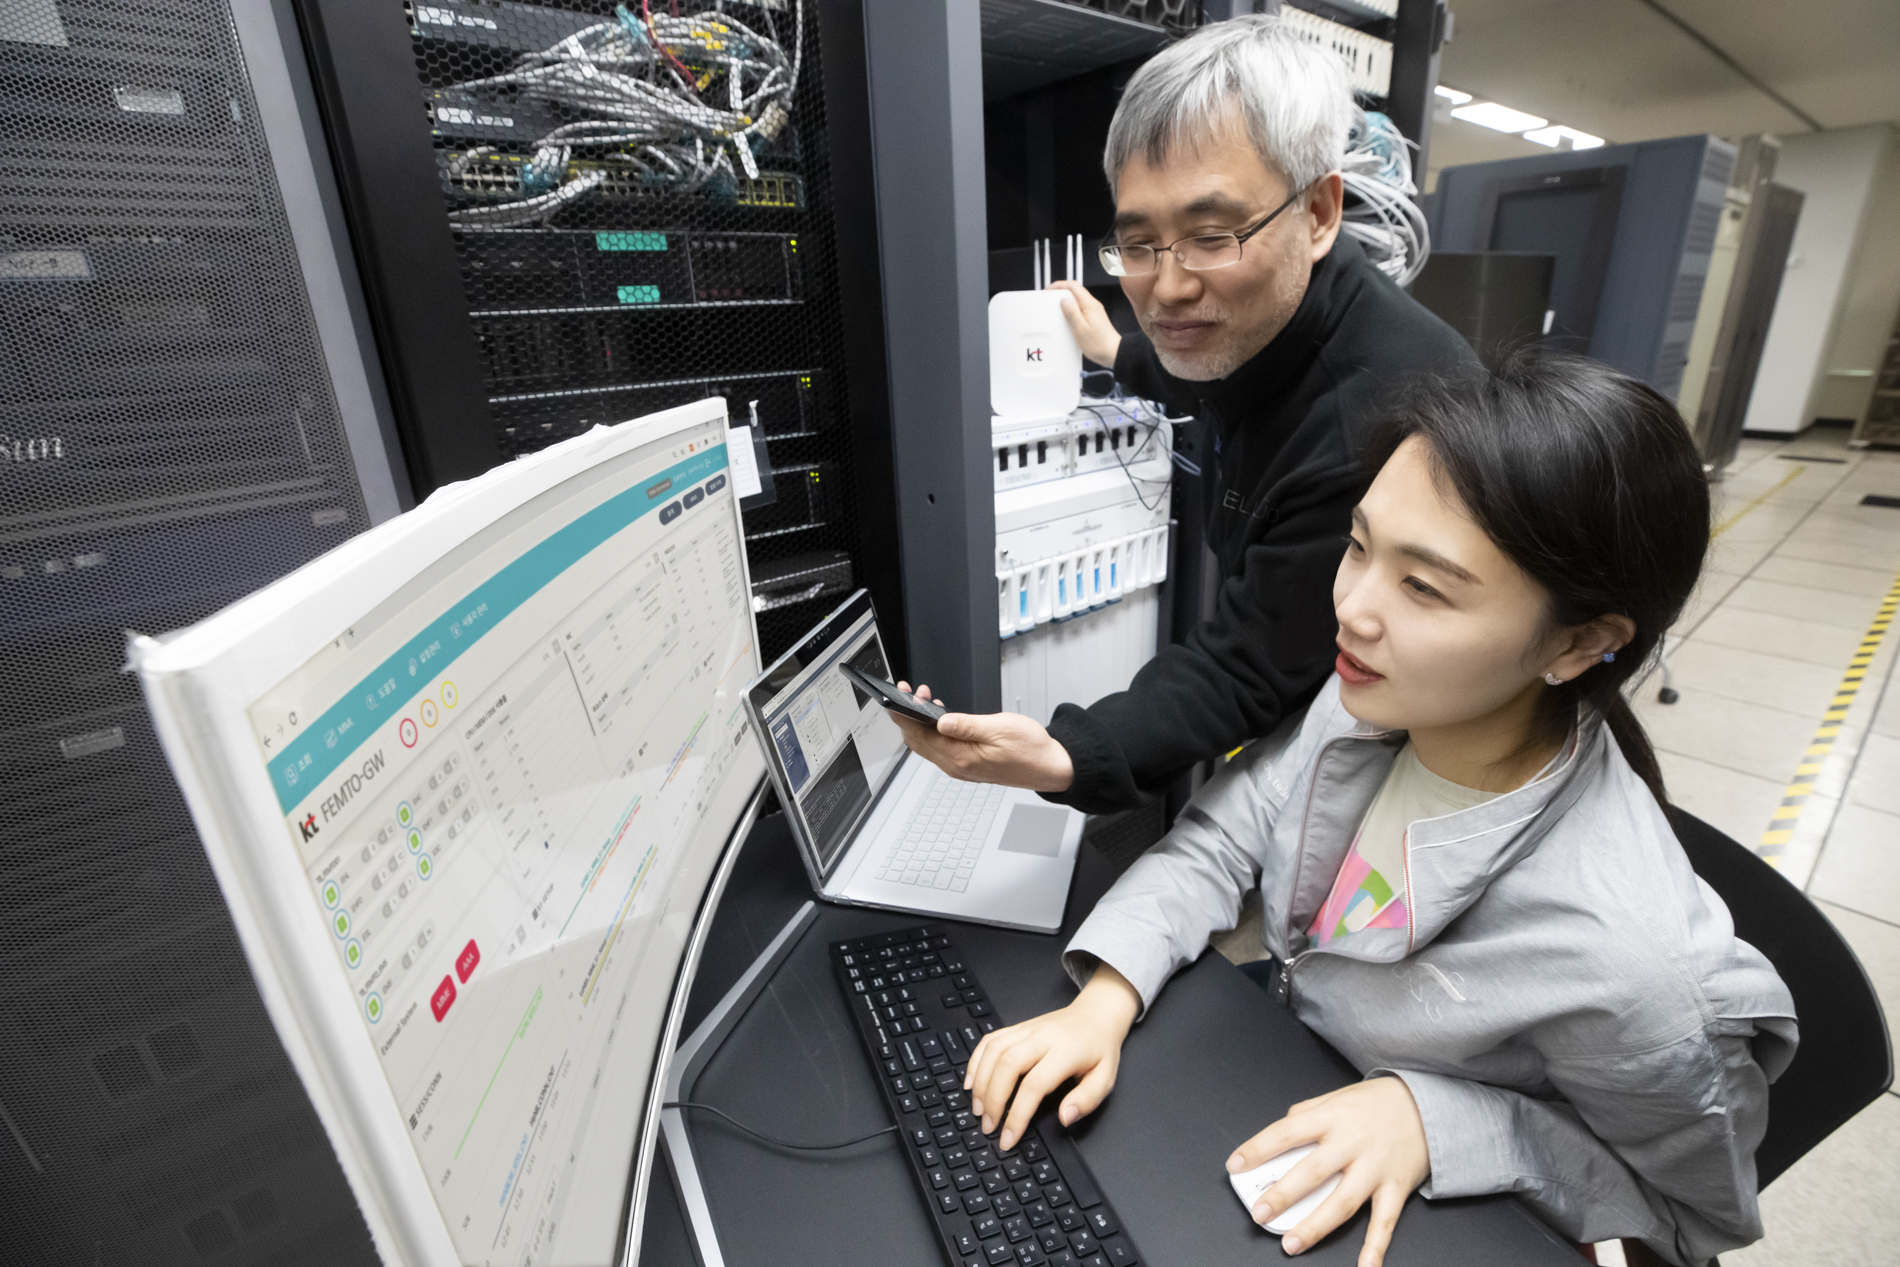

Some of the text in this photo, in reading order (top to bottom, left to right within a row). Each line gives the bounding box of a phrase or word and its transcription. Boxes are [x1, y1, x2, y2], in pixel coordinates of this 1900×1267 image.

[1026, 348, 1043, 362] kt
[419, 640, 442, 663] 설정관리
[378, 677, 396, 699] 도움말
[338, 717, 355, 736] MML
[297, 753, 312, 772] 조회
[298, 748, 386, 844] kt FEMTO-GW
[462, 952, 475, 972] AAA
[436, 987, 451, 1010] MME
[380, 1002, 418, 1056] External System
[415, 1070, 442, 1117] SESS/CONN
[934, 1173, 942, 1181] F6
[944, 1196, 951, 1204] F5
[962, 1237, 969, 1245] F4
